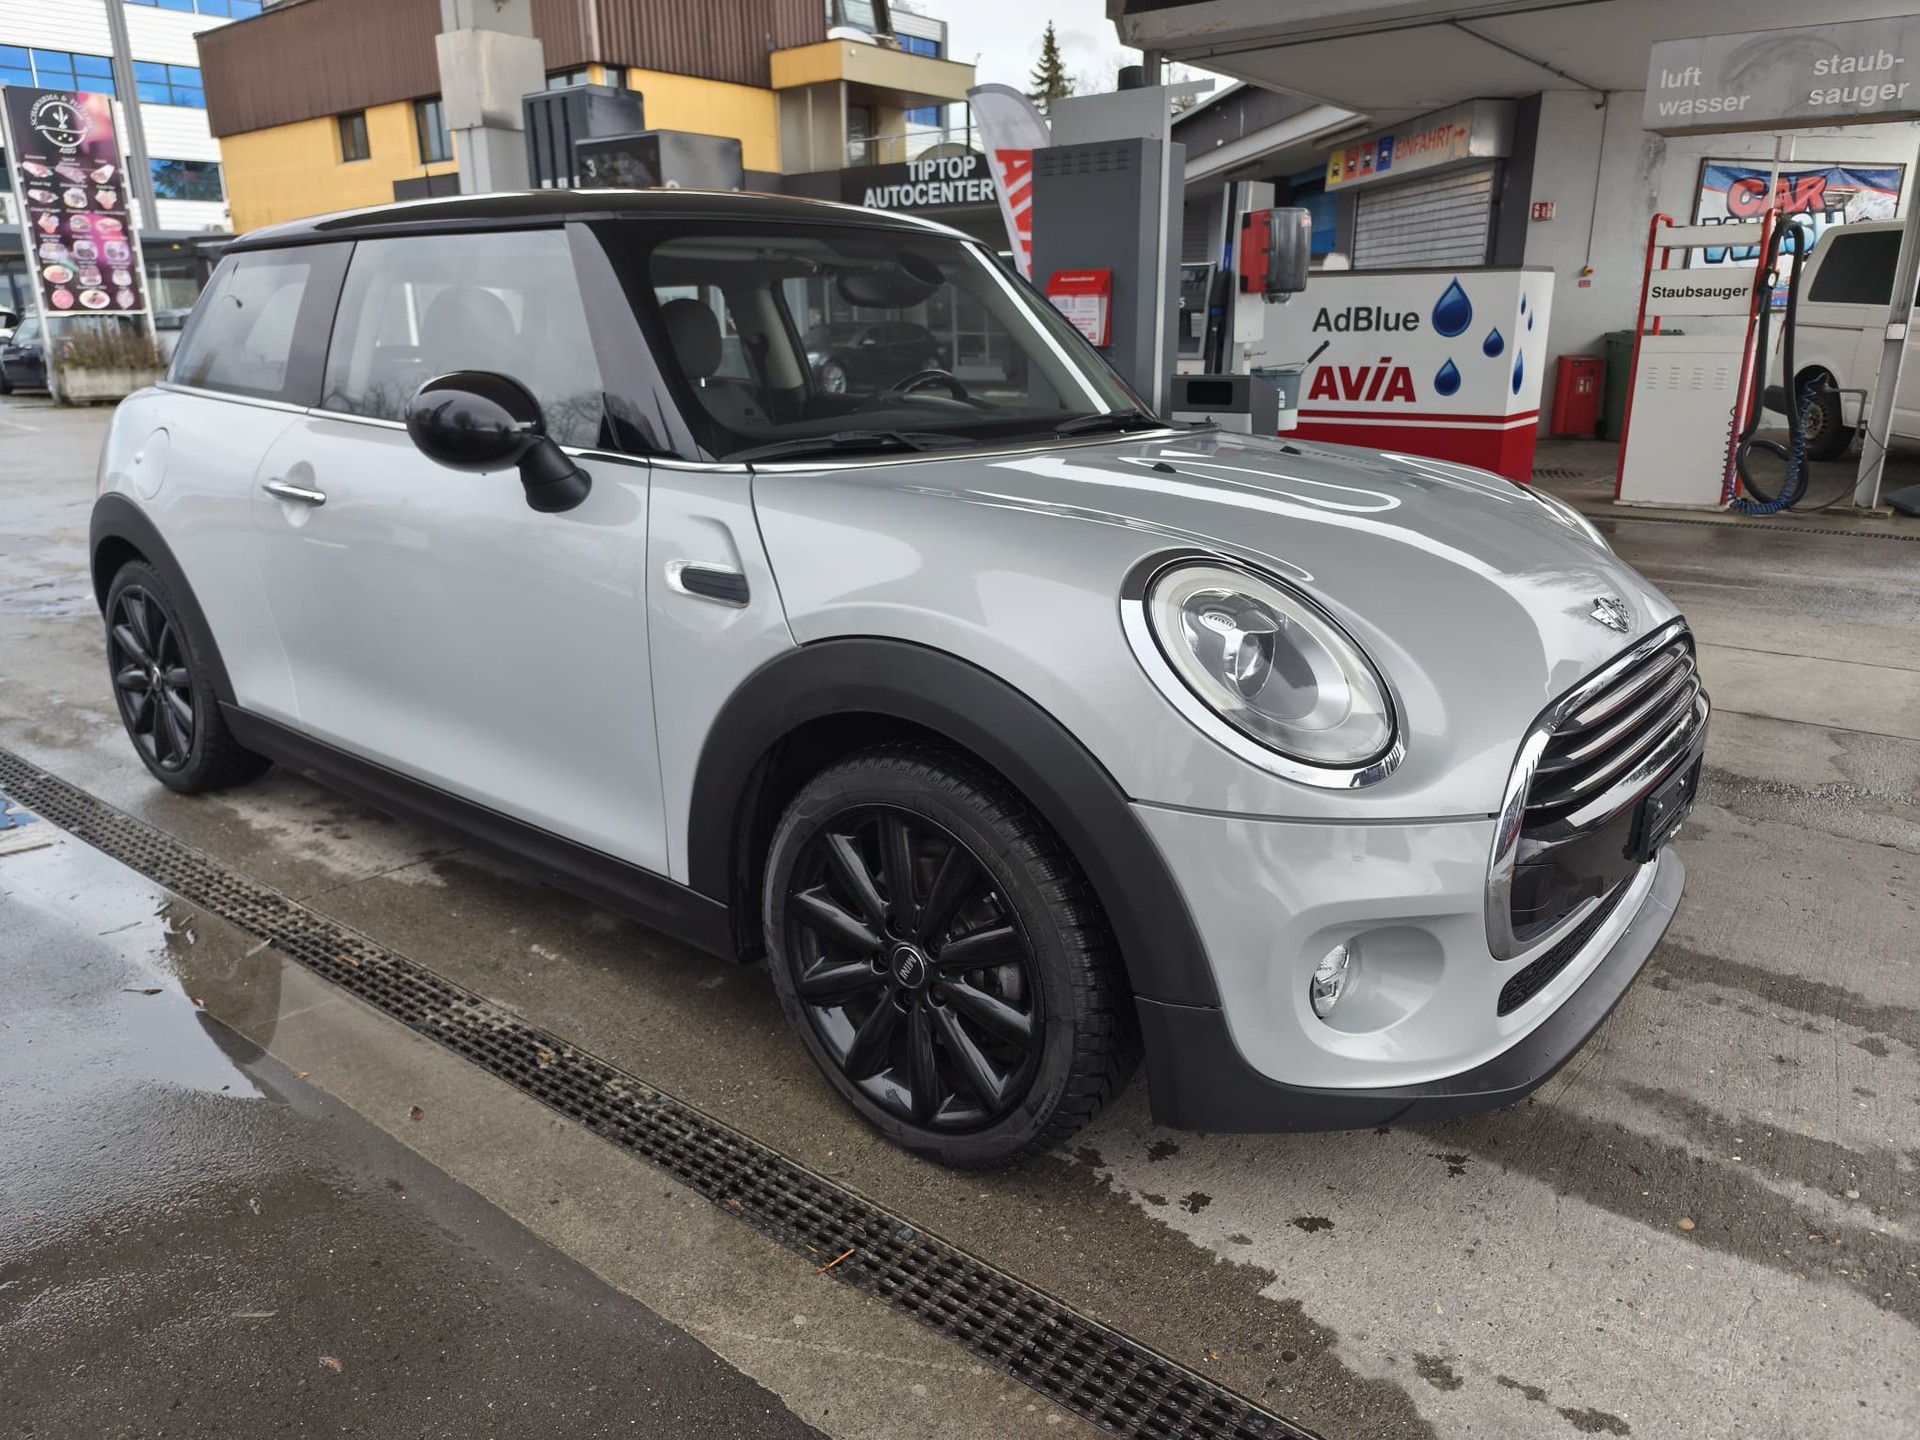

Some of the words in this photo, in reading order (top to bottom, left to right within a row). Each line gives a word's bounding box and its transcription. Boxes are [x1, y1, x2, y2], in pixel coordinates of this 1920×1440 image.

[1813, 49, 1905, 76] staub-
[1660, 67, 1702, 89] luft
[1658, 93, 1751, 116] wasser
[1808, 81, 1910, 107] sauger
[1394, 124, 1454, 161] EINFAHRT
[586, 159, 597, 178] 3
[906, 156, 977, 182] TIPTOP
[863, 178, 995, 209] AUTOCENTER
[1727, 176, 1827, 218] CAR
[1651, 285, 1749, 300] Staubsauger
[1312, 307, 1420, 332] AdBlue
[900, 954, 917, 980] MINI
